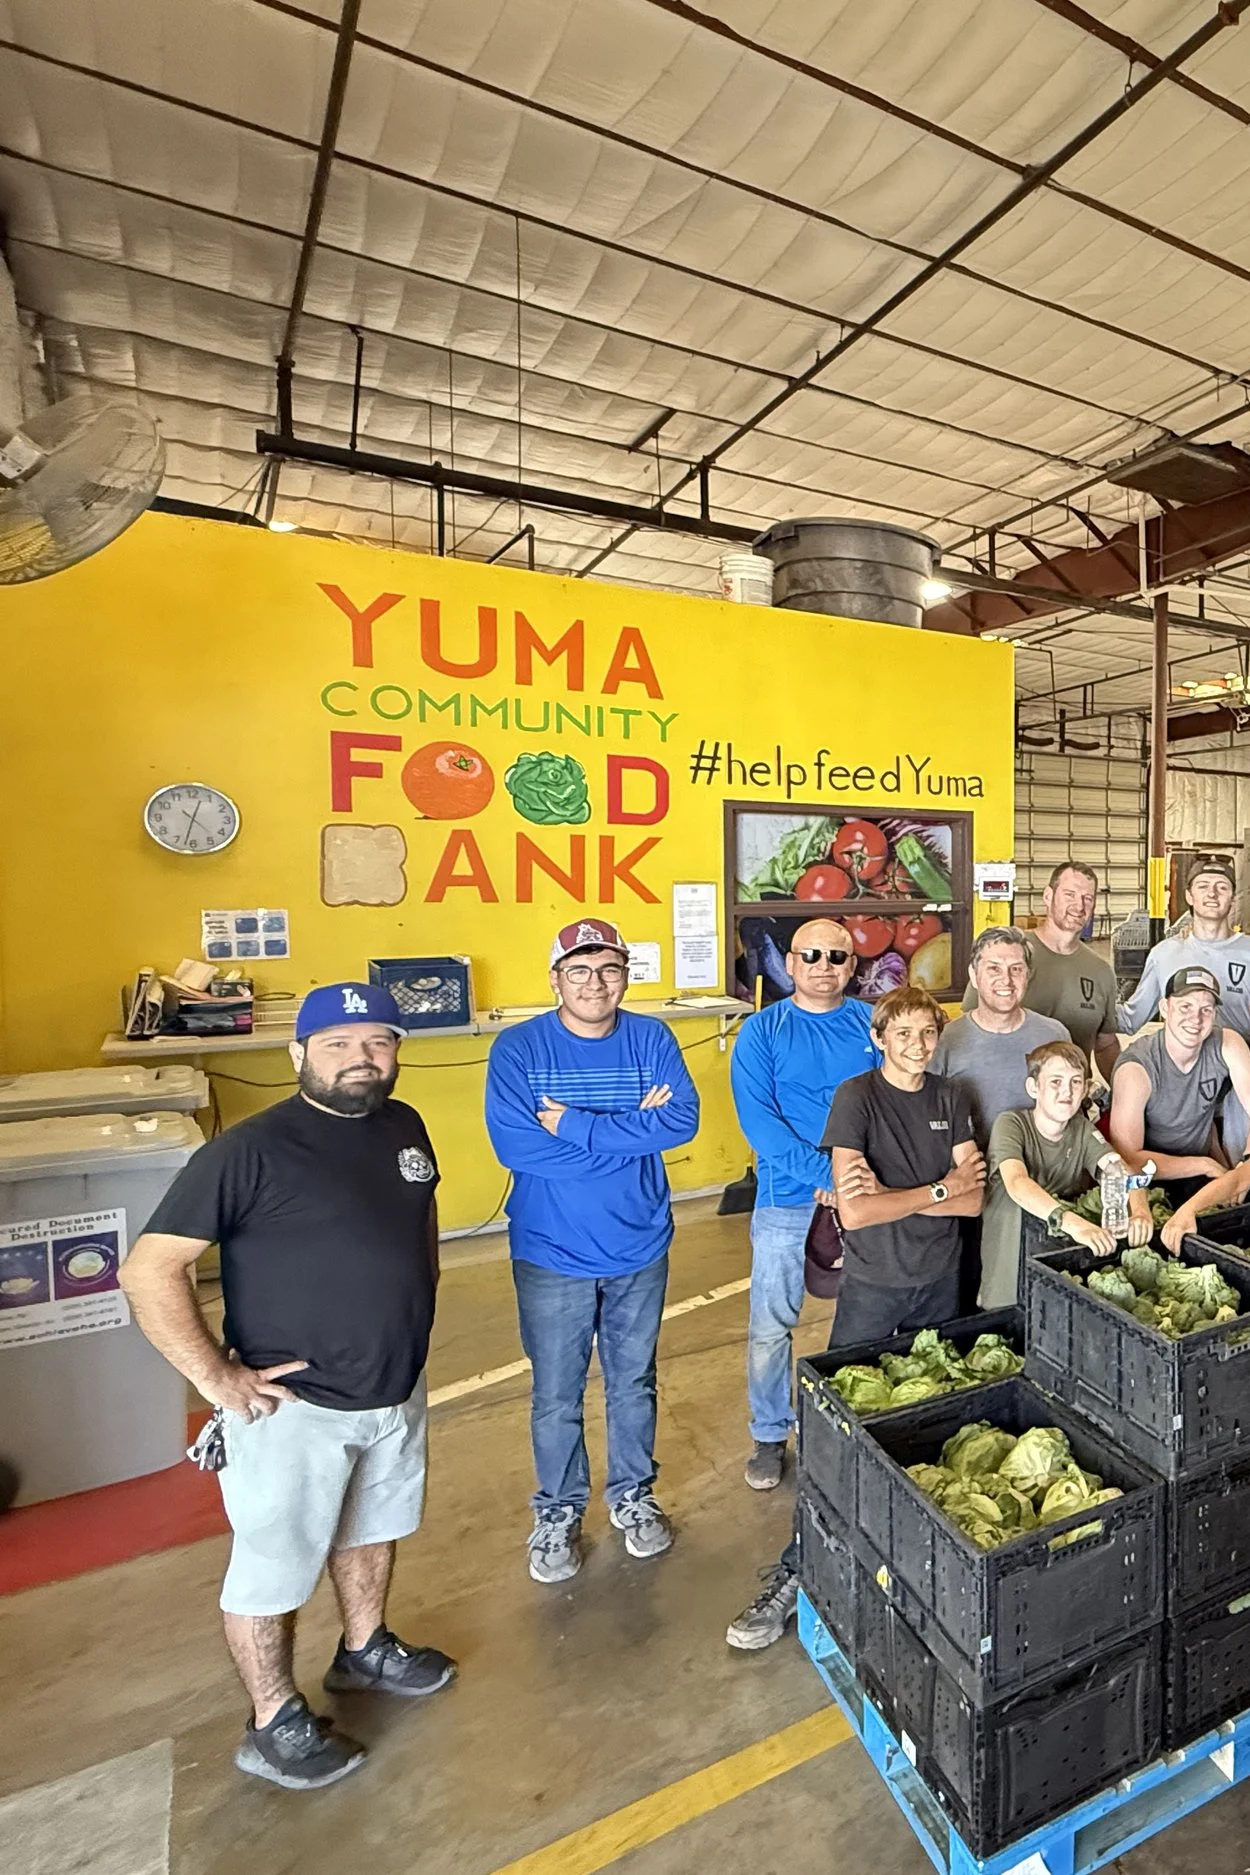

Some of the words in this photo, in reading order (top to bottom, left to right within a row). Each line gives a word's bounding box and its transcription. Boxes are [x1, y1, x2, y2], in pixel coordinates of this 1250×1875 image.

[316, 582, 664, 700] YUMA
[320, 681, 679, 742] COMMUNITY
[171, 793, 181, 802] 11
[186, 789, 199, 799] 12
[206, 795, 213, 803] 1
[157, 801, 171, 810] 10
[218, 804, 226, 814] 2
[223, 816, 231, 825] 3
[217, 827, 225, 836] 4
[173, 835, 181, 843] 7
[189, 839, 198, 849] 6
[206, 836, 214, 846] 5
[341, 988, 368, 1014] LA
[49, 1212, 118, 1228] Document
[11, 1224, 95, 1242] Destruction
